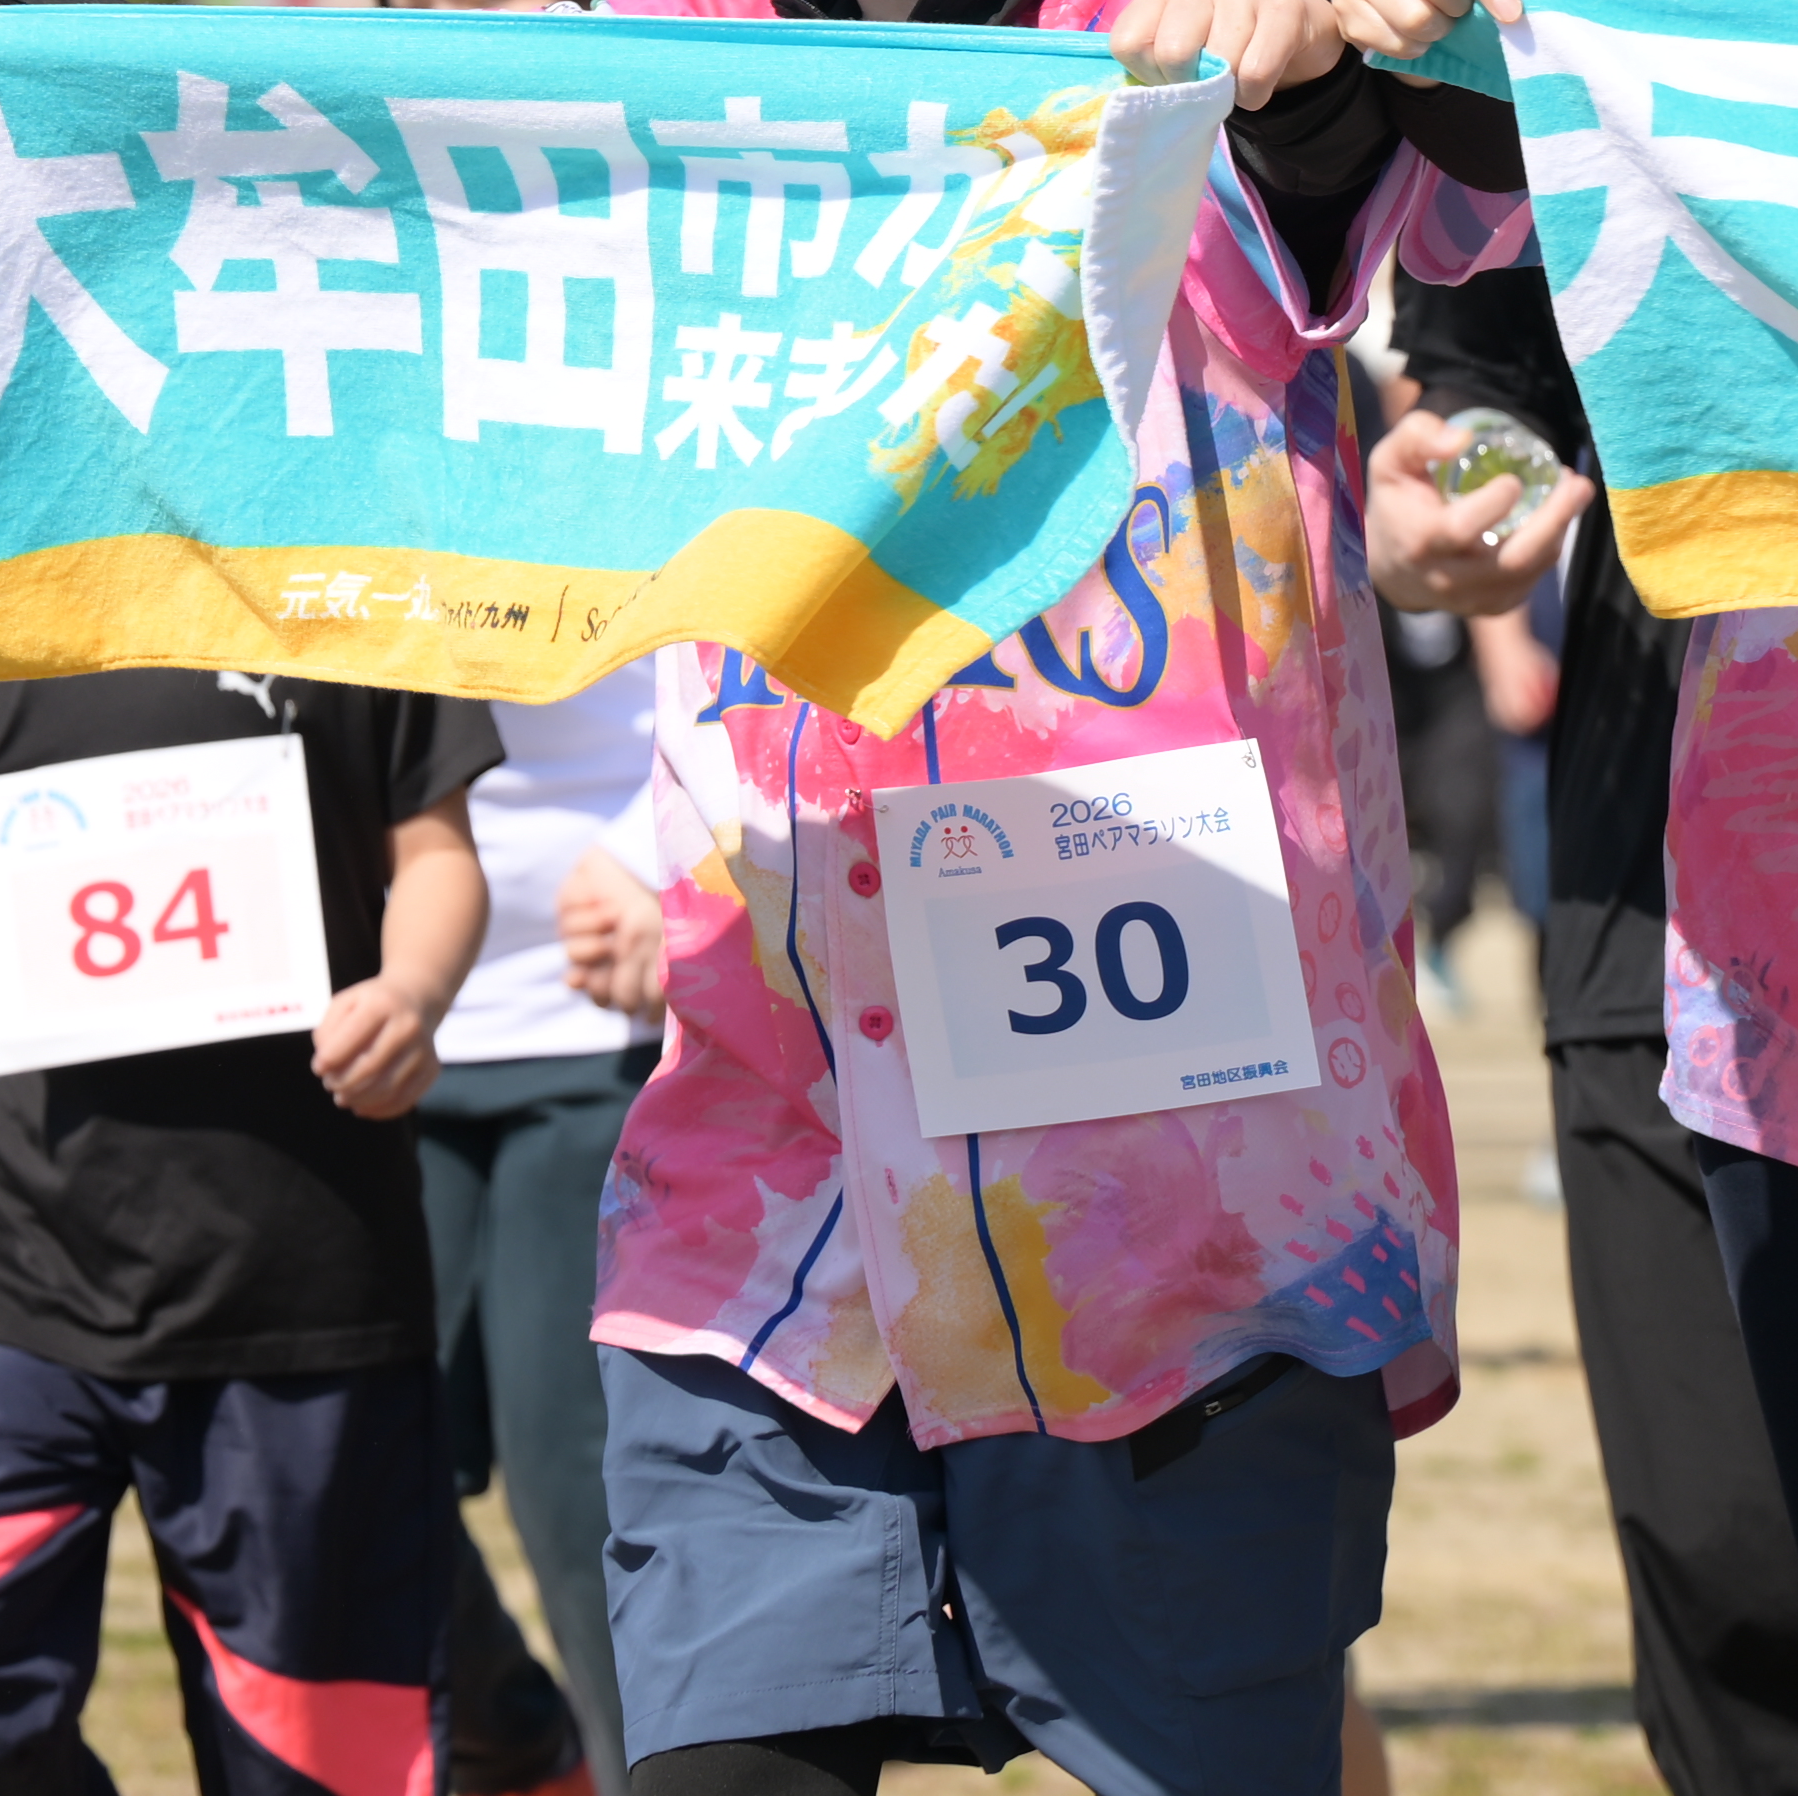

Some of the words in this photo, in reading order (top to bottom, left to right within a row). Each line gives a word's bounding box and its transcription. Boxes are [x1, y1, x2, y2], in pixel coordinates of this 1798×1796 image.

[909, 820, 932, 868] MIYADA
[930, 803, 957, 823] PAIR
[962, 804, 1014, 859] MARATHON
[1050, 792, 1133, 828] 2026
[1054, 806, 1231, 861] 宮田ペアマラソン大会
[69, 867, 229, 978] 84
[994, 900, 1190, 1036] 30
